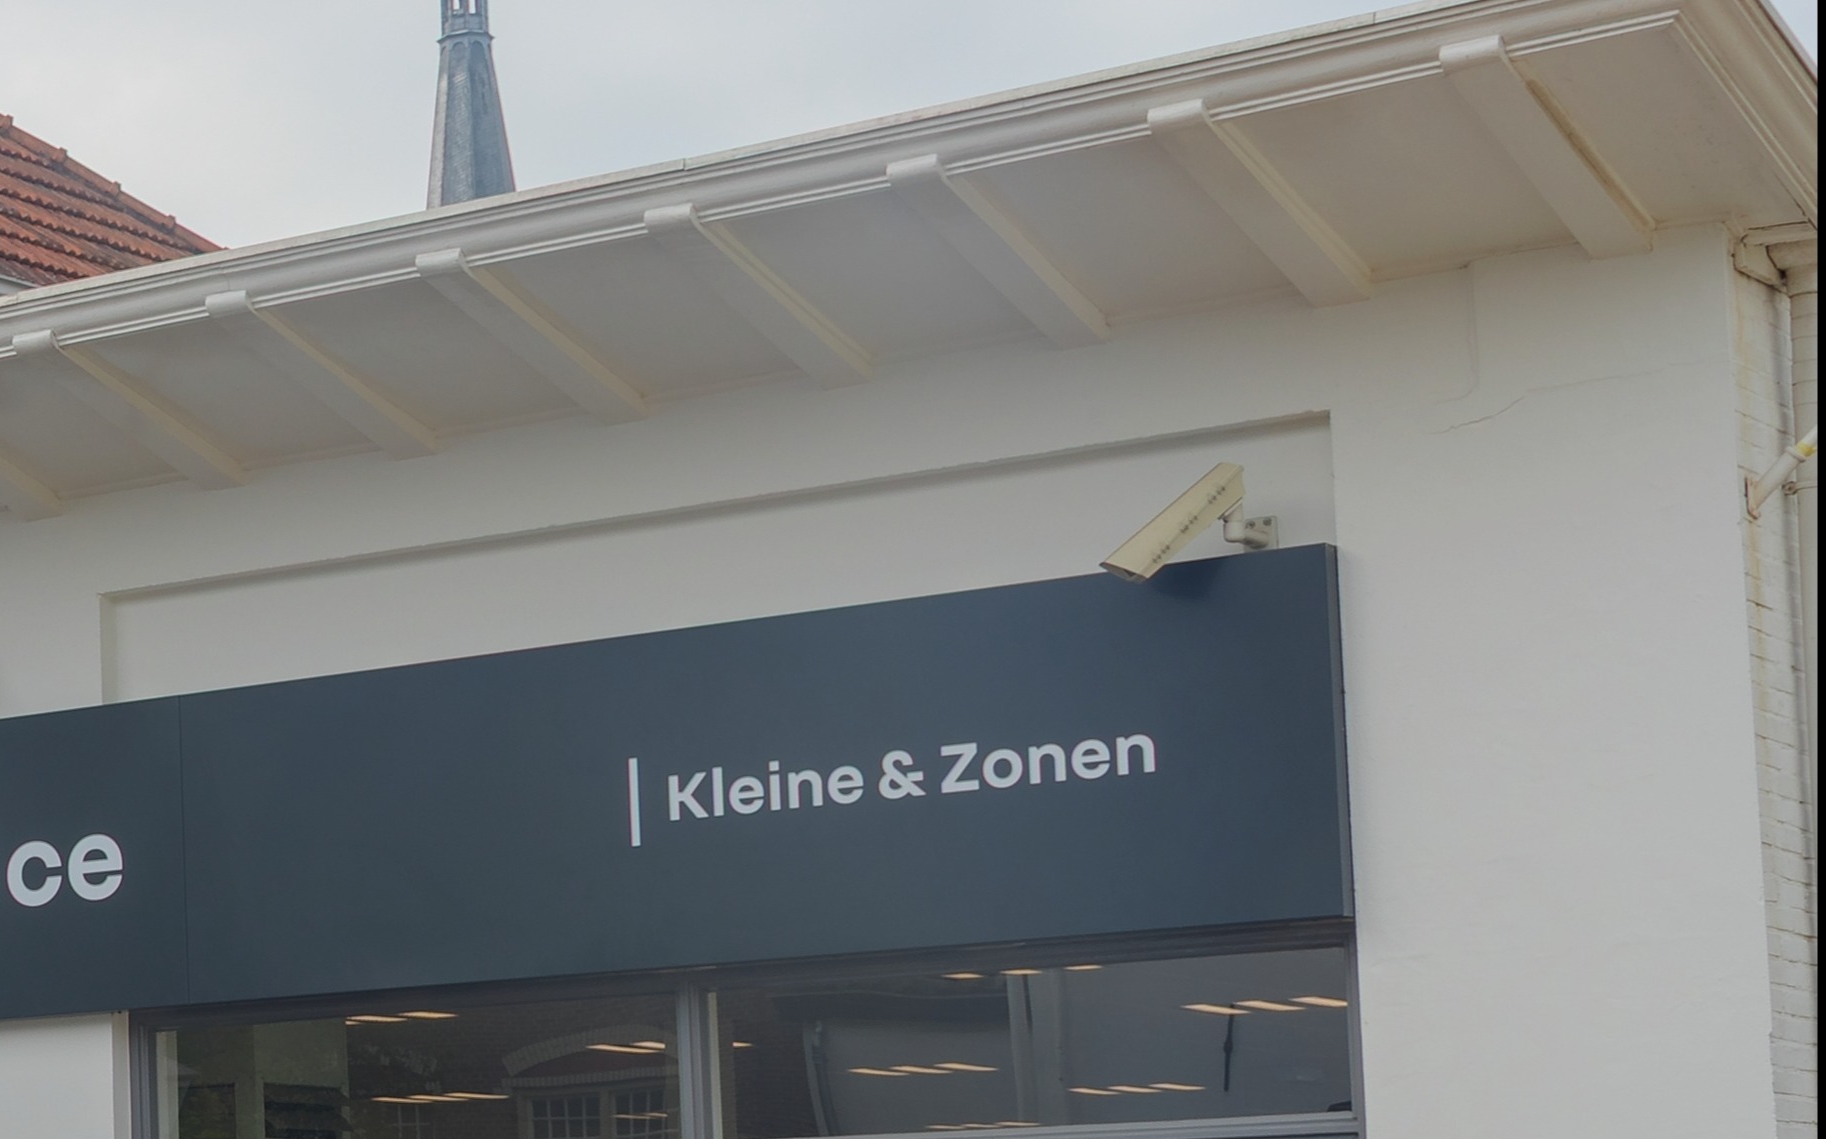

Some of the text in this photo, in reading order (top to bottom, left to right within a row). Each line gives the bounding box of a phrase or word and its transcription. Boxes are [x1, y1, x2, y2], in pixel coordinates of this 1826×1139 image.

[668, 734, 1156, 821] Kleine & Zonen
